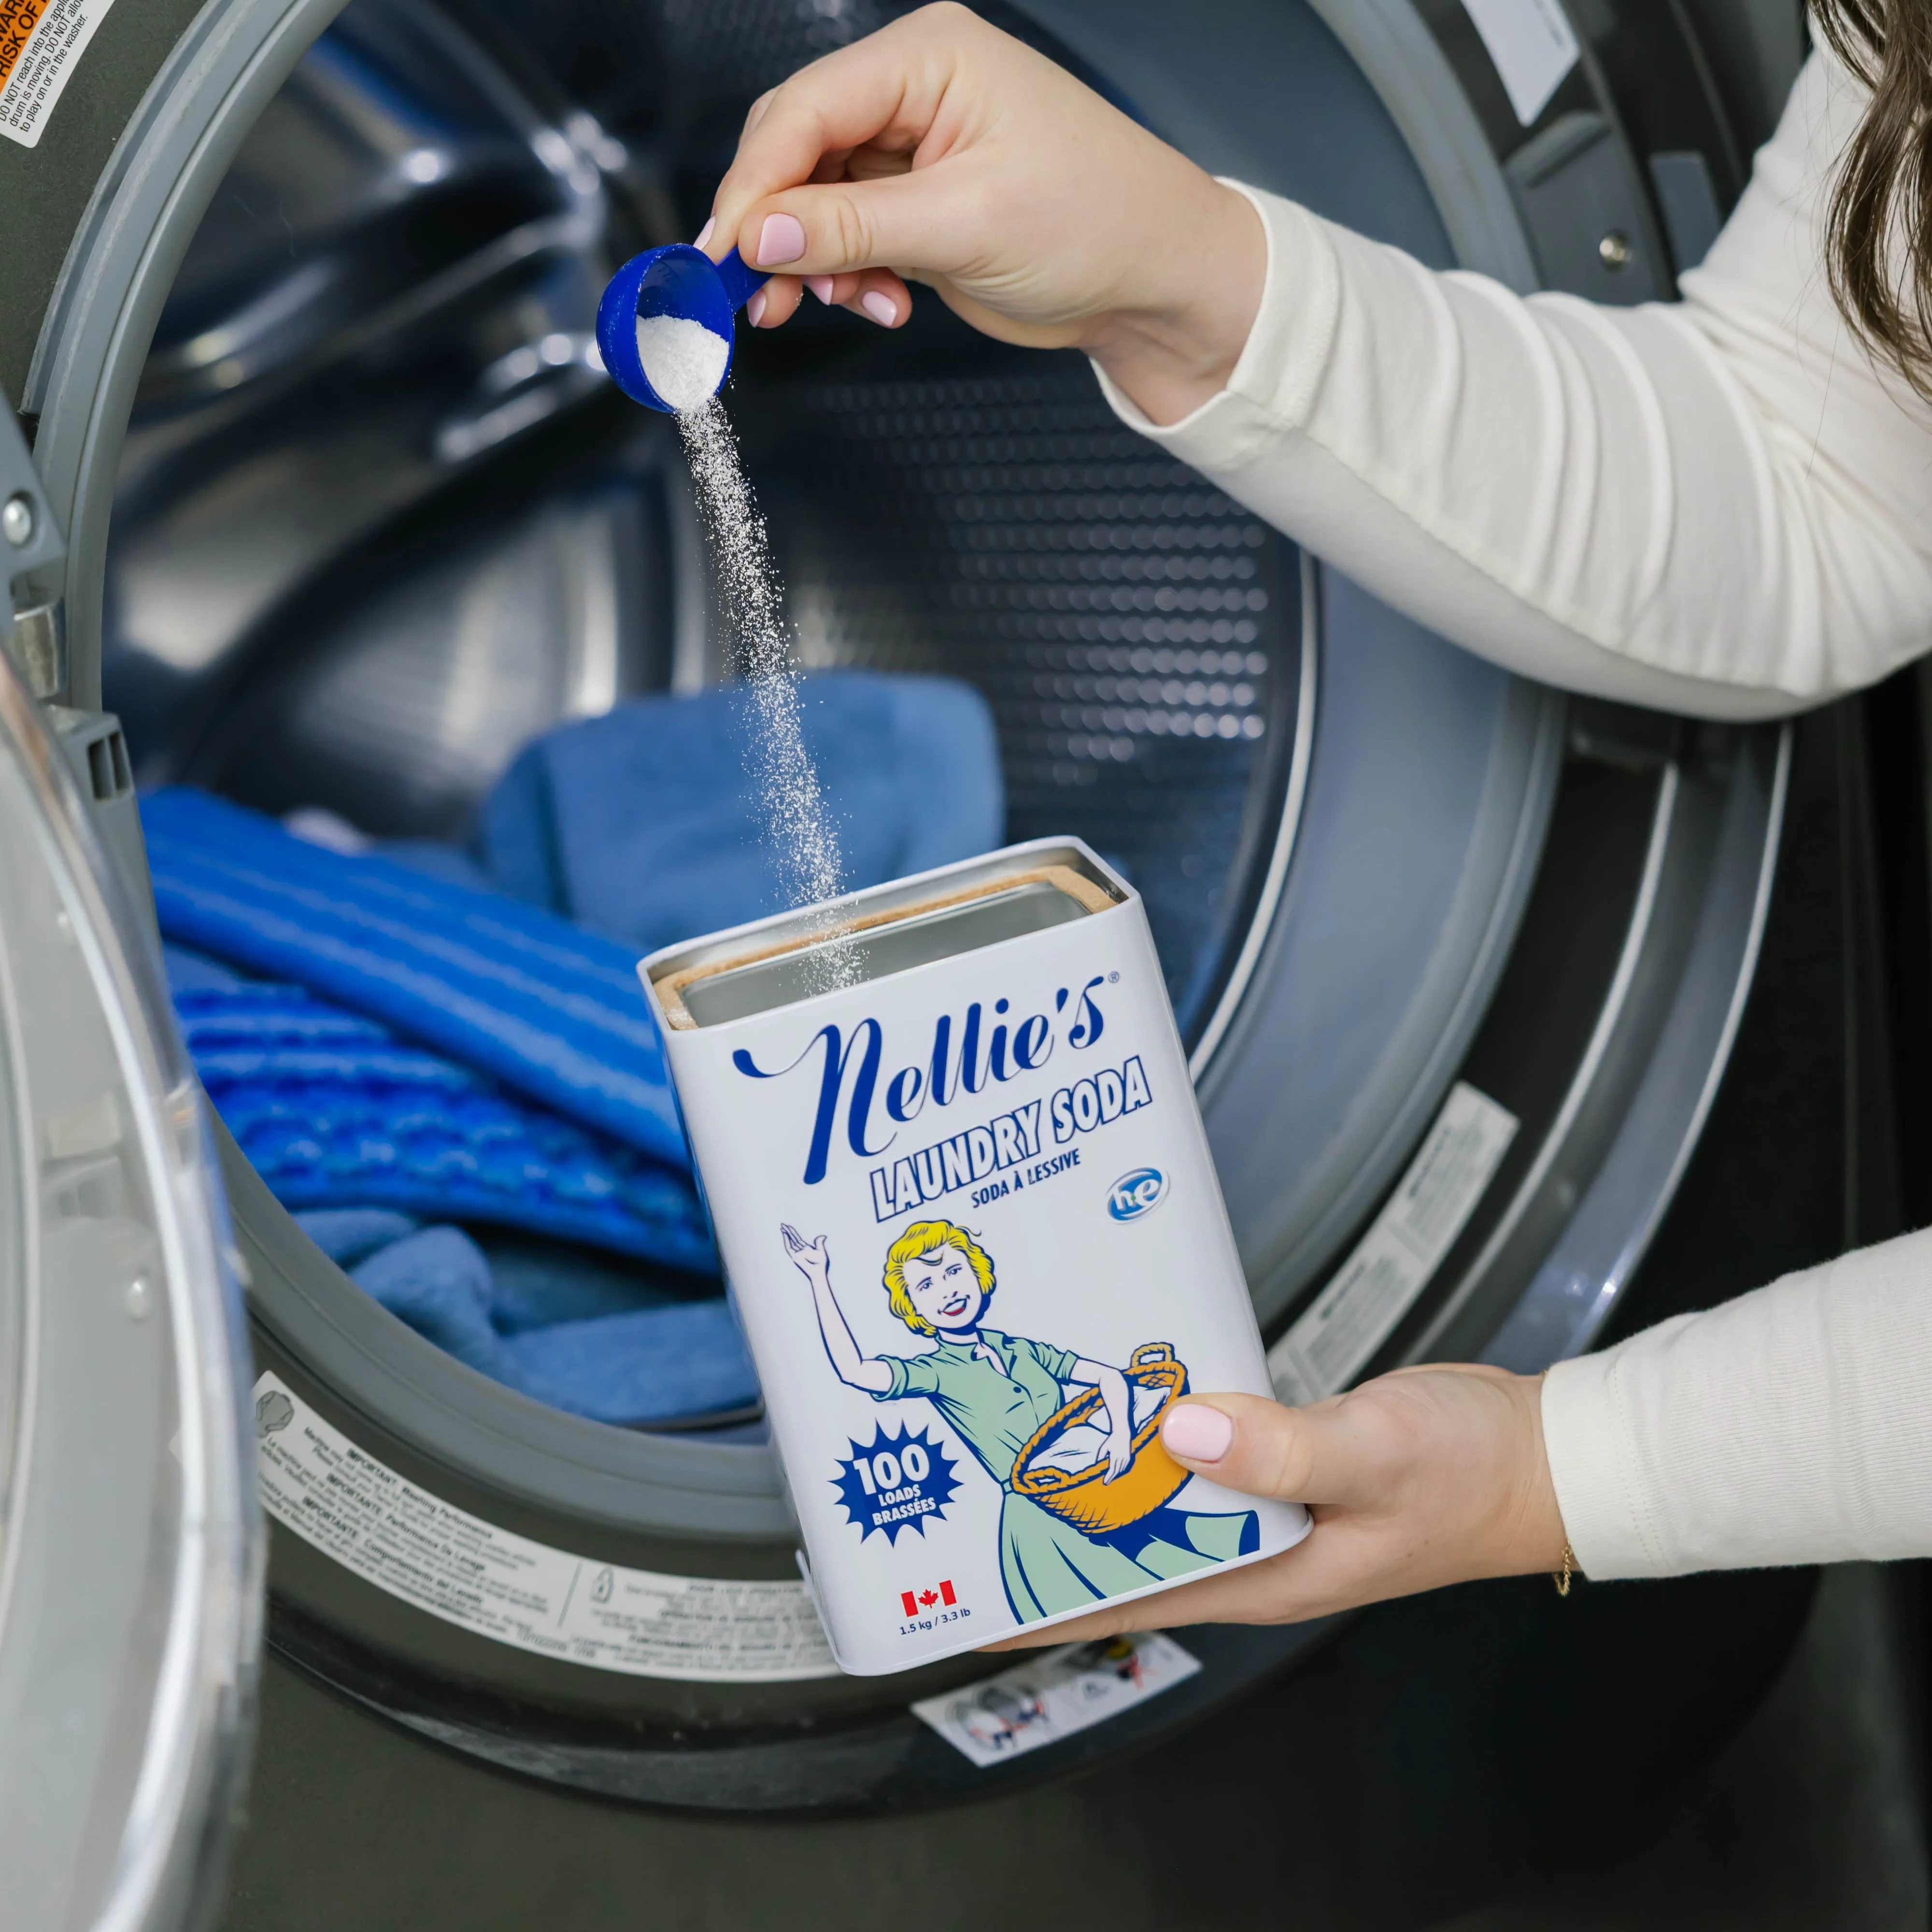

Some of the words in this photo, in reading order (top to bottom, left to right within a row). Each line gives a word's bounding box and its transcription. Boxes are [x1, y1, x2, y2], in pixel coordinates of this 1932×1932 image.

[0, 0, 25, 42] AR
[50, 0, 69, 21] appli
[0, 30, 26, 78] RISK
[18, 1, 38, 30] OF
[39, 21, 54, 37] the
[64, 14, 88, 48] washer.
[29, 38, 45, 56] into
[53, 49, 67, 64] the
[9, 101, 27, 127] drum
[20, 91, 31, 100] is
[27, 56, 51, 90] moving.
[44, 37, 58, 53] DO
[54, 15, 70, 38] NOT
[68, 0, 84, 17] allo
[17, 56, 35, 83] reach
[47, 65, 58, 75] in
[43, 74, 53, 86] or
[4, 82, 20, 105] NOT
[36, 87, 47, 100] on
[0, 105, 10, 121] DO
[26, 100, 42, 122] play
[19, 122, 30, 132] to
[869, 1098, 1042, 1223] LAUNDRY
[1050, 1055, 1152, 1144] SODA
[971, 1179, 1009, 1208] SODA
[1014, 1170, 1023, 1191] À
[1028, 1148, 1081, 1185] LESSIVE
[852, 1444, 929, 1495] 100
[878, 1484, 921, 1506] LOADS
[872, 1497, 936, 1526] BRASSÉES
[900, 1623, 916, 1635] 1.5
[919, 1620, 932, 1630] kg
[935, 1616, 938, 1626] /
[941, 1611, 958, 1623] 3.3
[960, 1608, 970, 1618] lb
